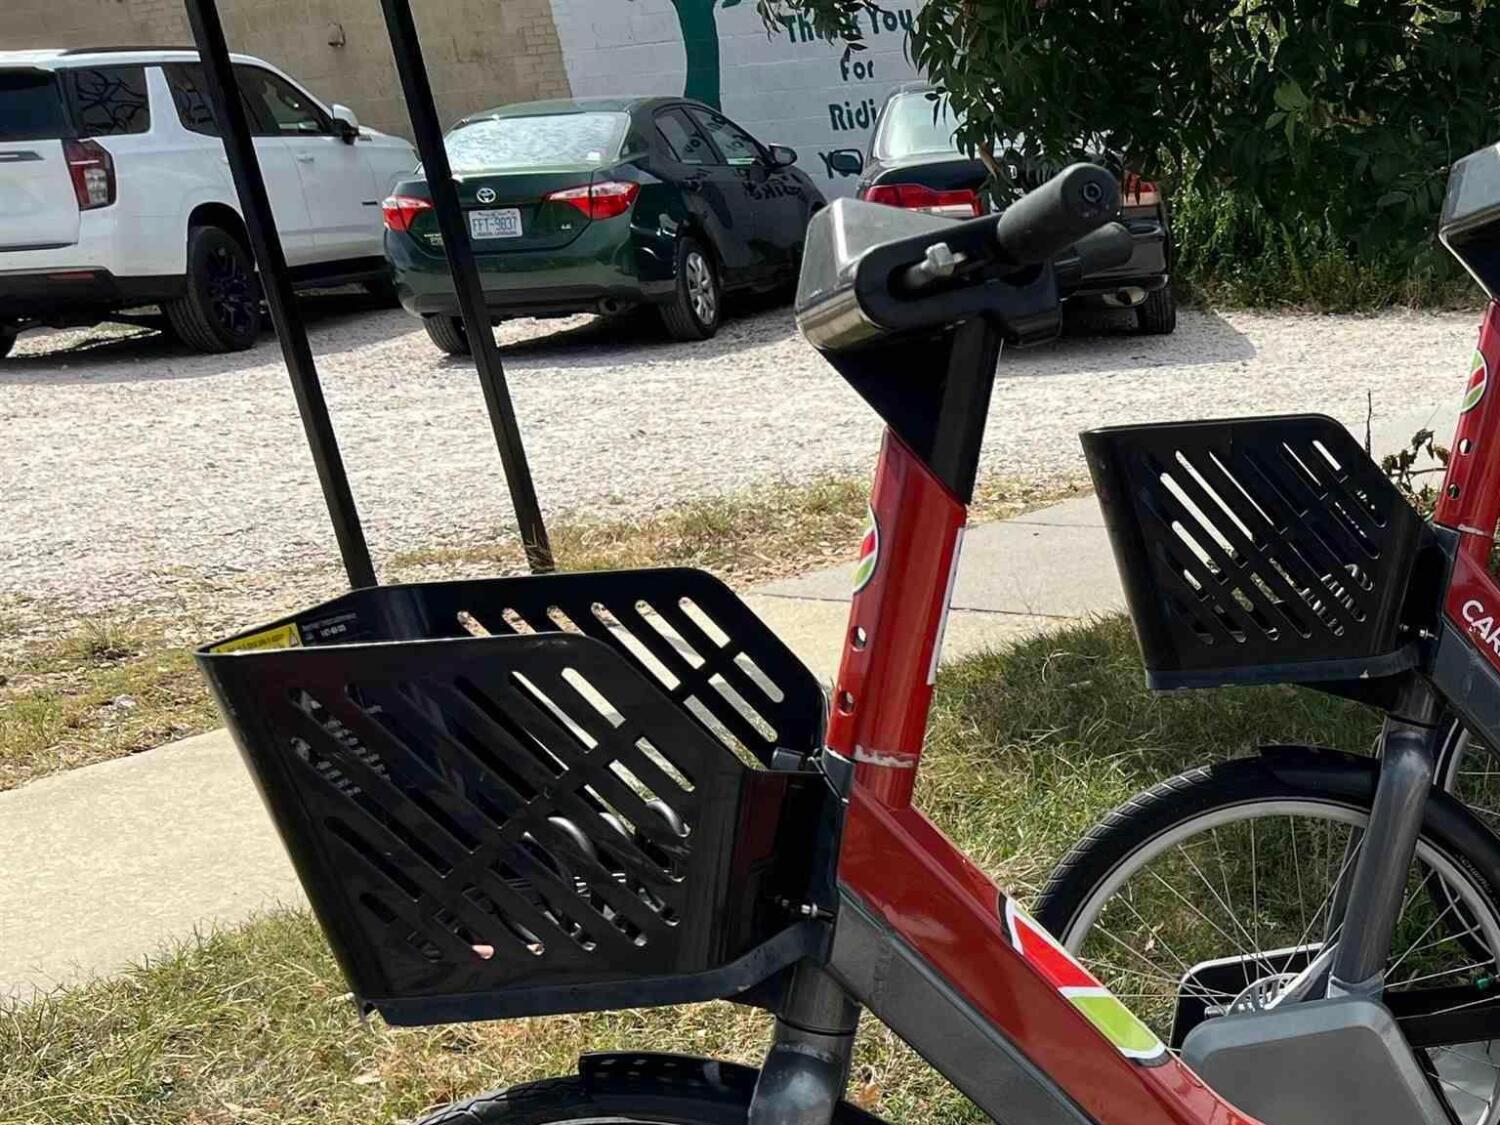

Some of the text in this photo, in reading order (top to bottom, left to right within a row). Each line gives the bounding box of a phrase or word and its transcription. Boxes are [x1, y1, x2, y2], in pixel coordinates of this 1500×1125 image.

[865, 7, 914, 35] You
[841, 57, 874, 81] For
[829, 98, 877, 131] Ridi
